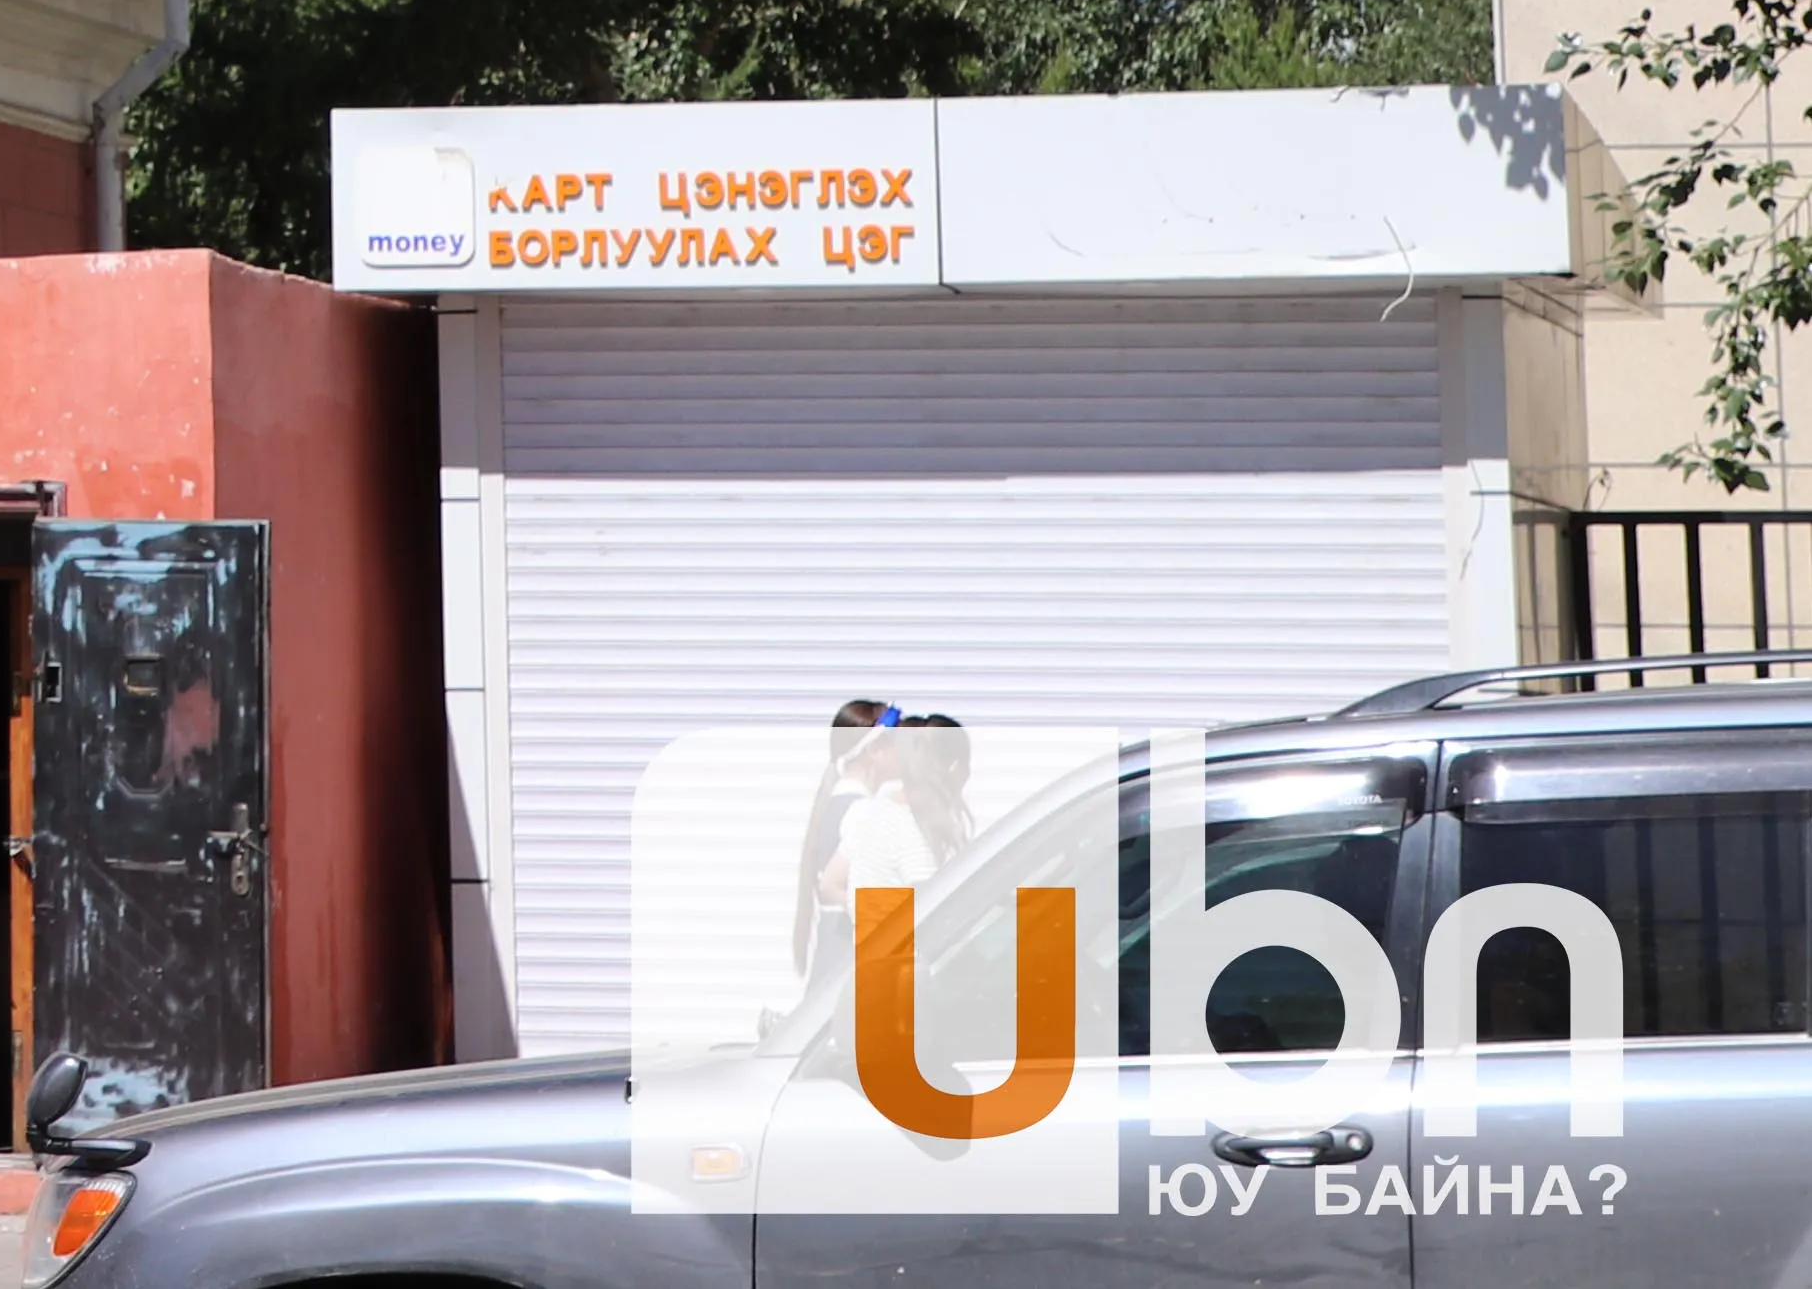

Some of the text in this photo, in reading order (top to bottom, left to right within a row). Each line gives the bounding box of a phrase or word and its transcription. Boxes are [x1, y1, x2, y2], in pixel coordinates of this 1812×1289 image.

[658, 168, 913, 217] ЦЭНЭГЛЭХ
[368, 233, 465, 257] money
[488, 224, 914, 271] БОРЛУУЛАХ ЦЭГ
